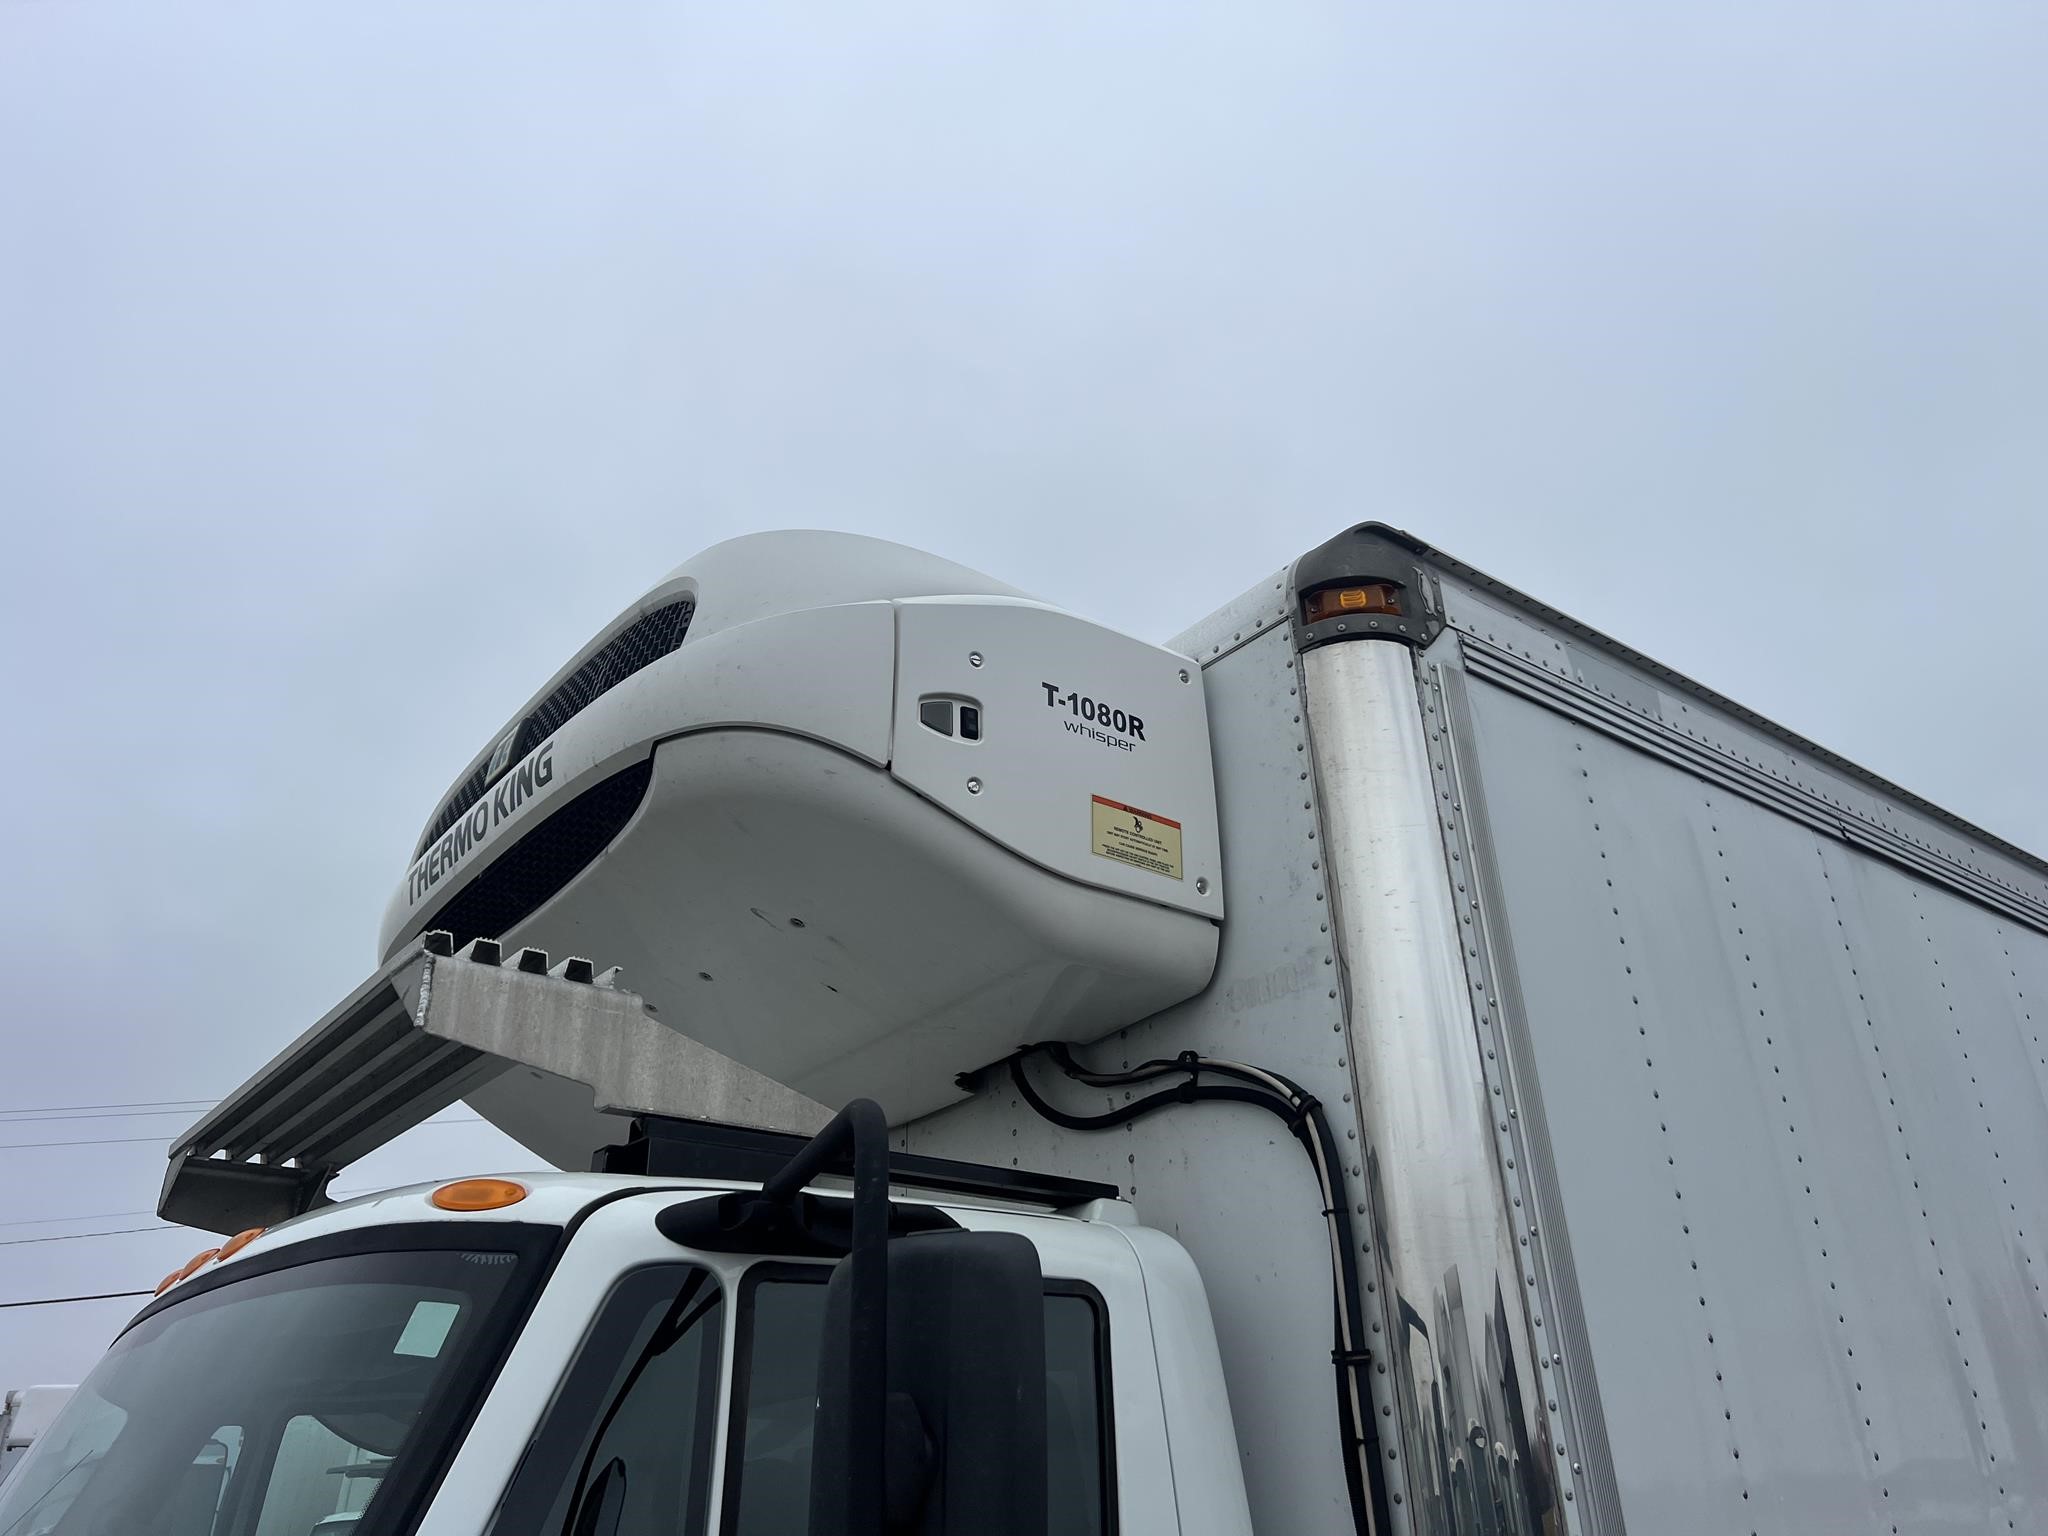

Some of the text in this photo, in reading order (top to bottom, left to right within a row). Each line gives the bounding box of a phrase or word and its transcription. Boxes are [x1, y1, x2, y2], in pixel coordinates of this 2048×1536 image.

[1041, 681, 1146, 742] T-1080R
[1063, 720, 1136, 752] whisper
[407, 740, 554, 906] THERMO KING
